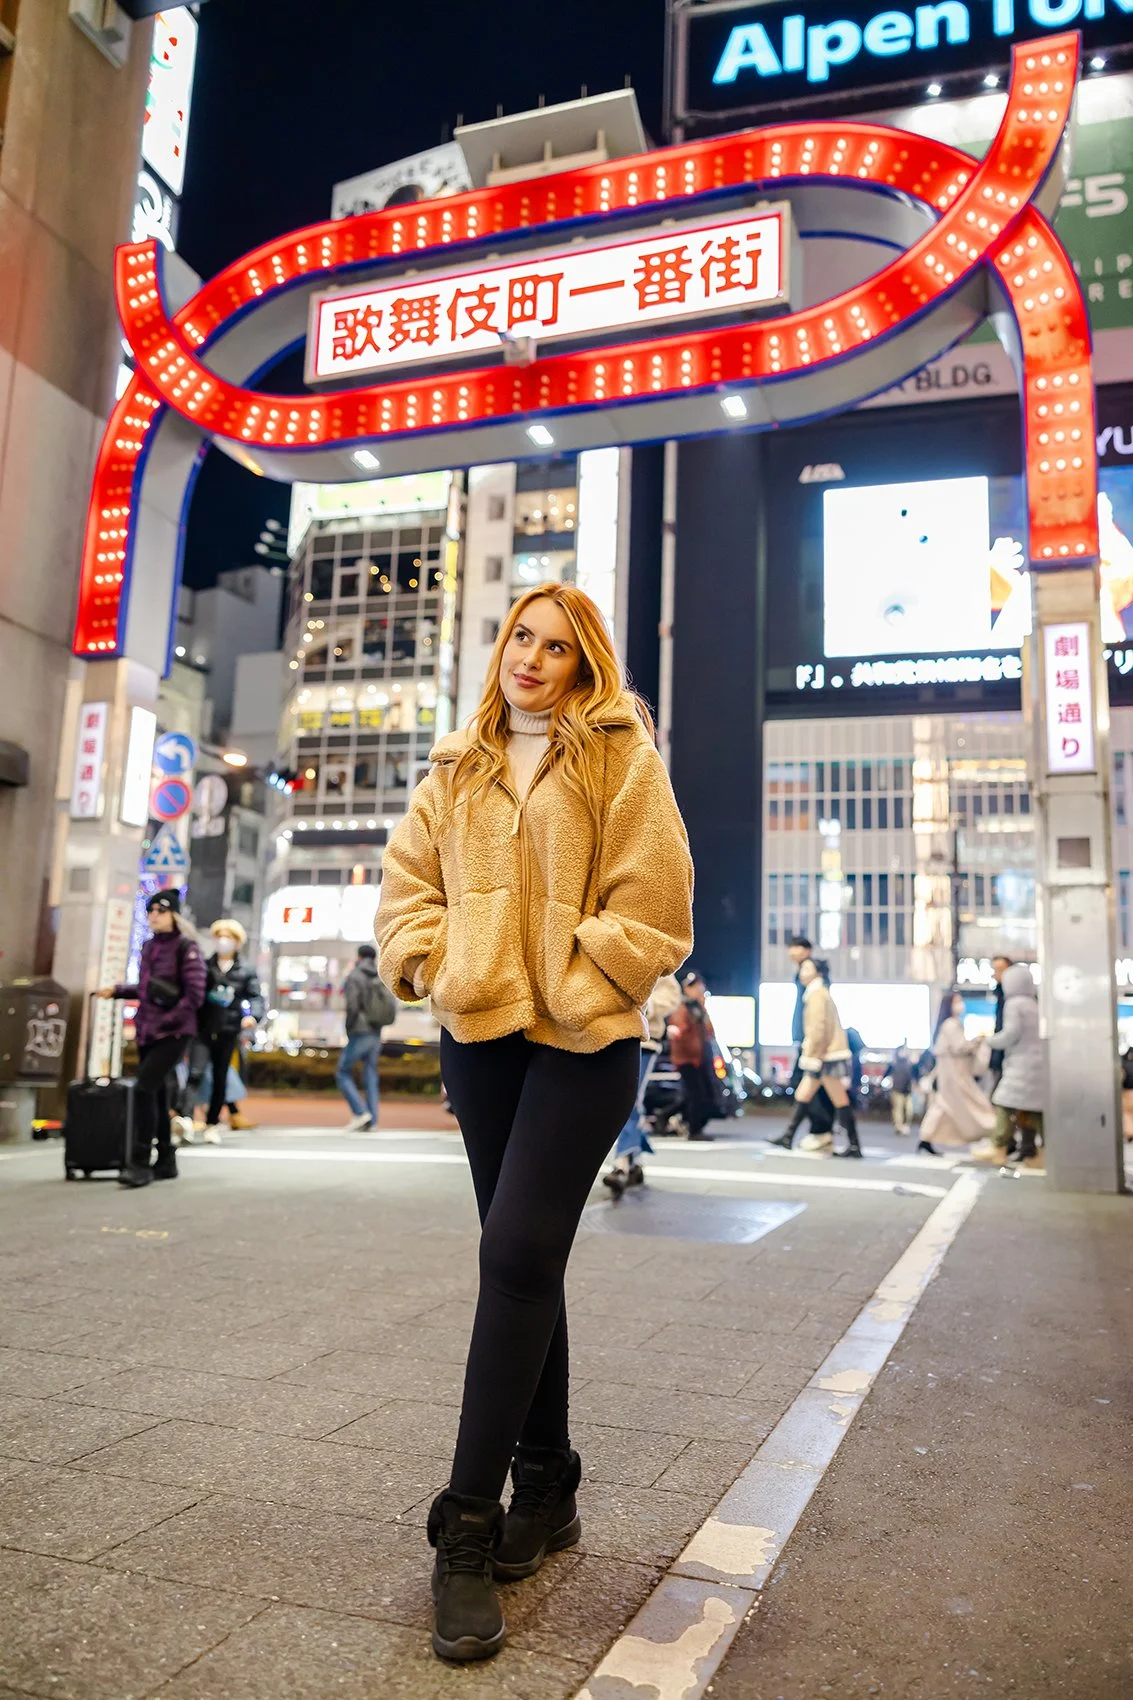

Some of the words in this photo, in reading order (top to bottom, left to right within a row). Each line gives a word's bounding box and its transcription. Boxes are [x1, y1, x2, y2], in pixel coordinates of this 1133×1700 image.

[713, 1, 969, 84] Alpen
[332, 232, 762, 360] 歌舞伎町一番街
[1054, 635, 1082, 758] 劇場通り
